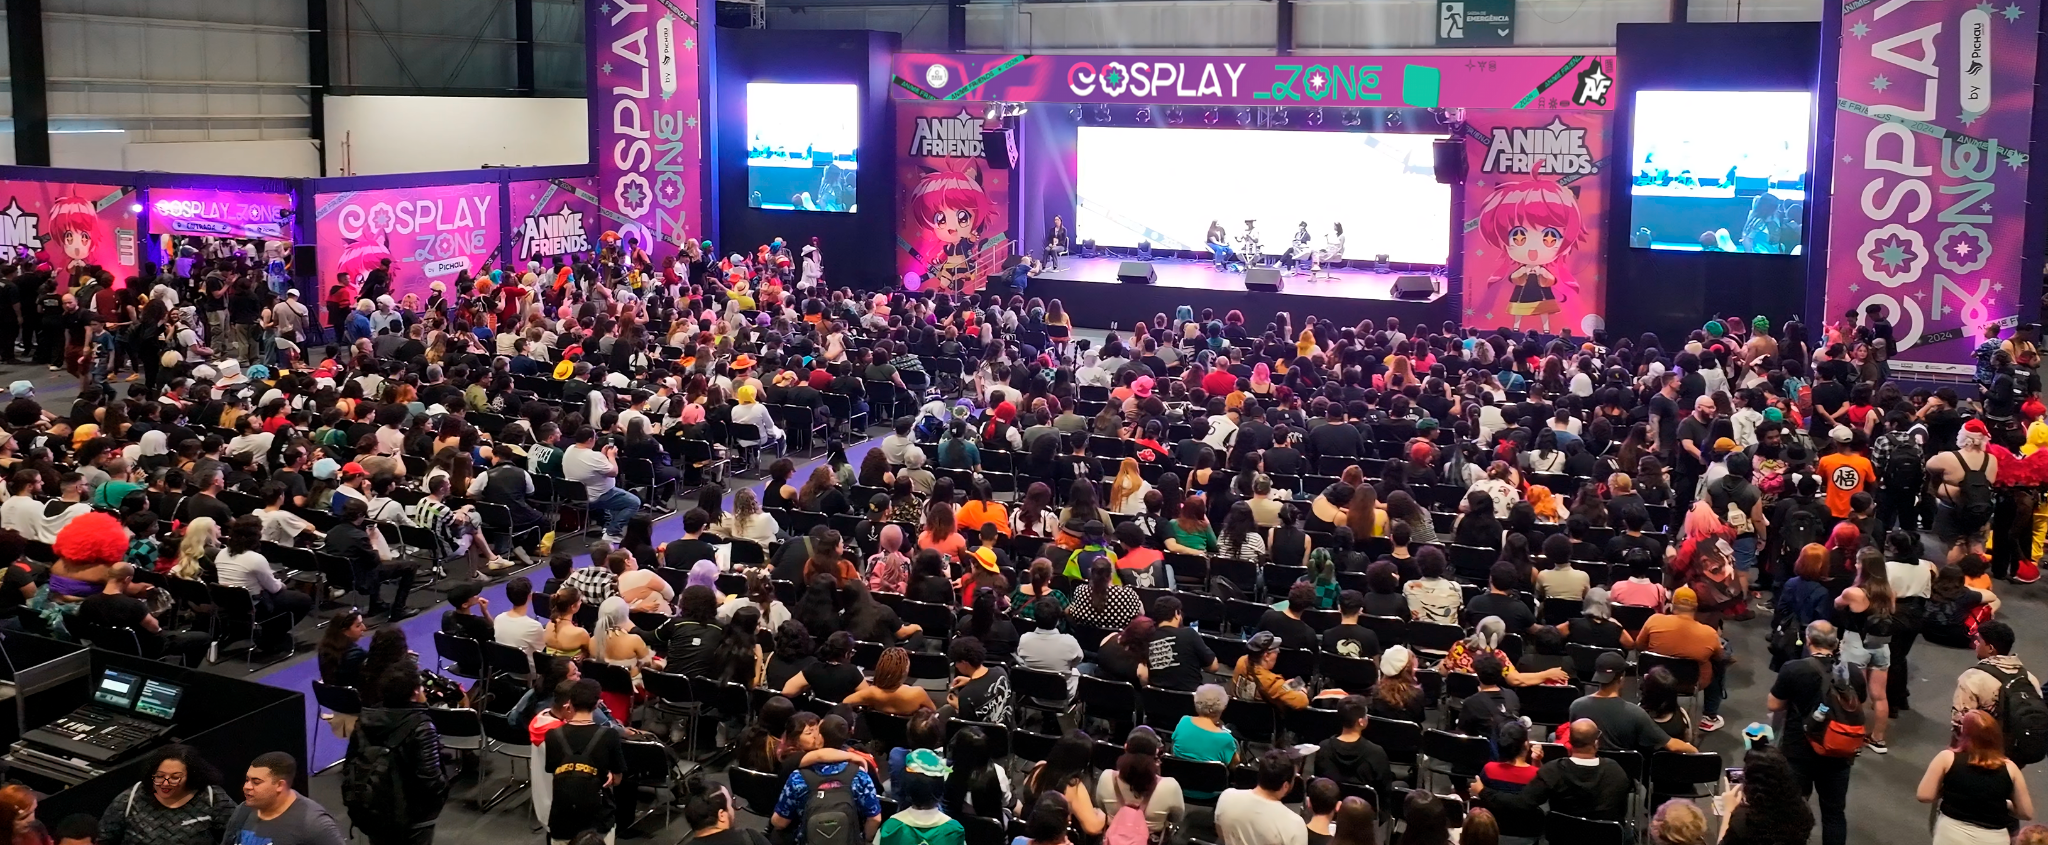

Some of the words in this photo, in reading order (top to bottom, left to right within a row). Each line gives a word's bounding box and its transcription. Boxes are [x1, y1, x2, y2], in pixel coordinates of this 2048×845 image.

[1067, 61, 1247, 97] COSPLAY
[911, 118, 985, 155] ANIME
[1910, 121, 1935, 134] 2024
[1482, 128, 1588, 172] ANIME
[338, 196, 491, 239] COSPLAY
[520, 211, 584, 259] ANIME
[1928, 332, 1953, 344] 2024
[1834, 469, 1857, 487] 悟
